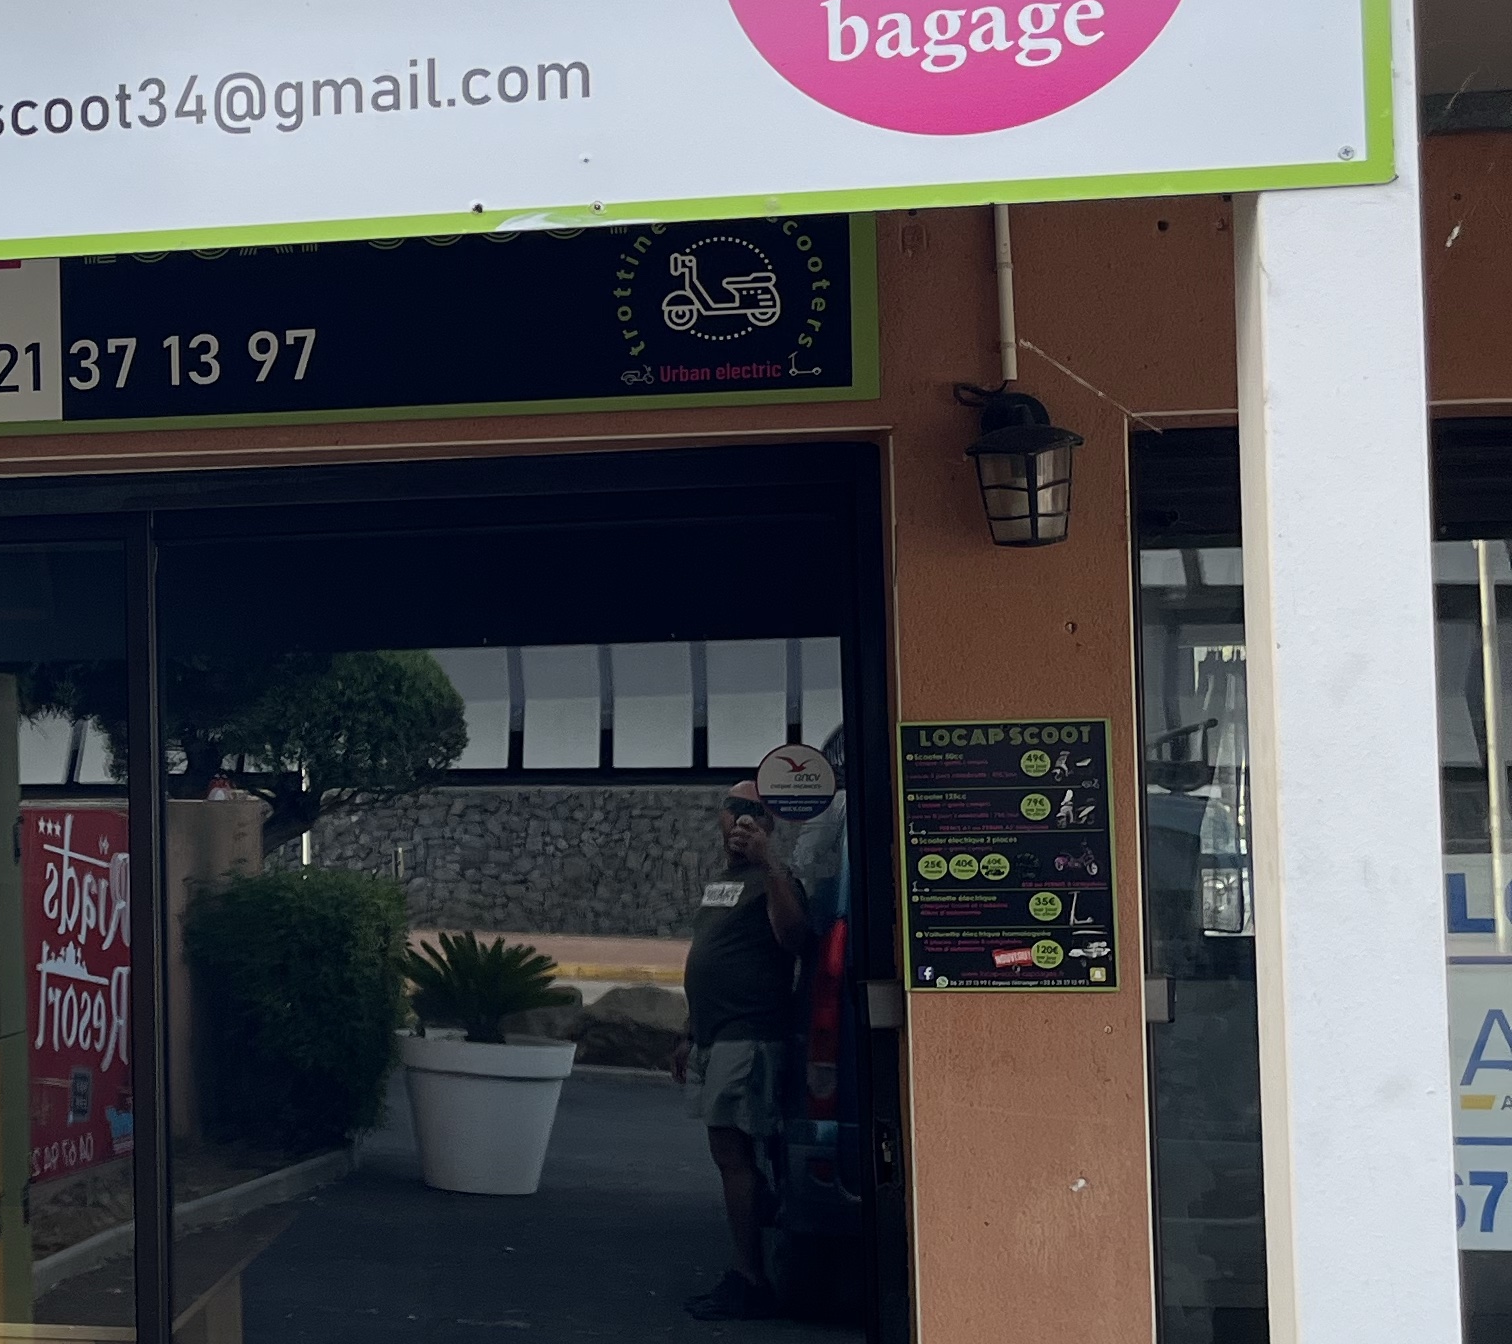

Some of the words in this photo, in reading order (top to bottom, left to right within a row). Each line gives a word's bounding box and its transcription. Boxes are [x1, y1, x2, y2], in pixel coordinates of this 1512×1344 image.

[69, 337, 137, 391] 37
[162, 334, 221, 388] 13
[248, 328, 317, 383] 97
[660, 365, 710, 383] Urban
[716, 361, 782, 379] electric
[1026, 754, 1046, 762] 49€
[1026, 797, 1045, 806] 79€
[923, 860, 942, 869] 25€
[955, 859, 973, 868] 40€
[1034, 897, 1056, 906] 35€
